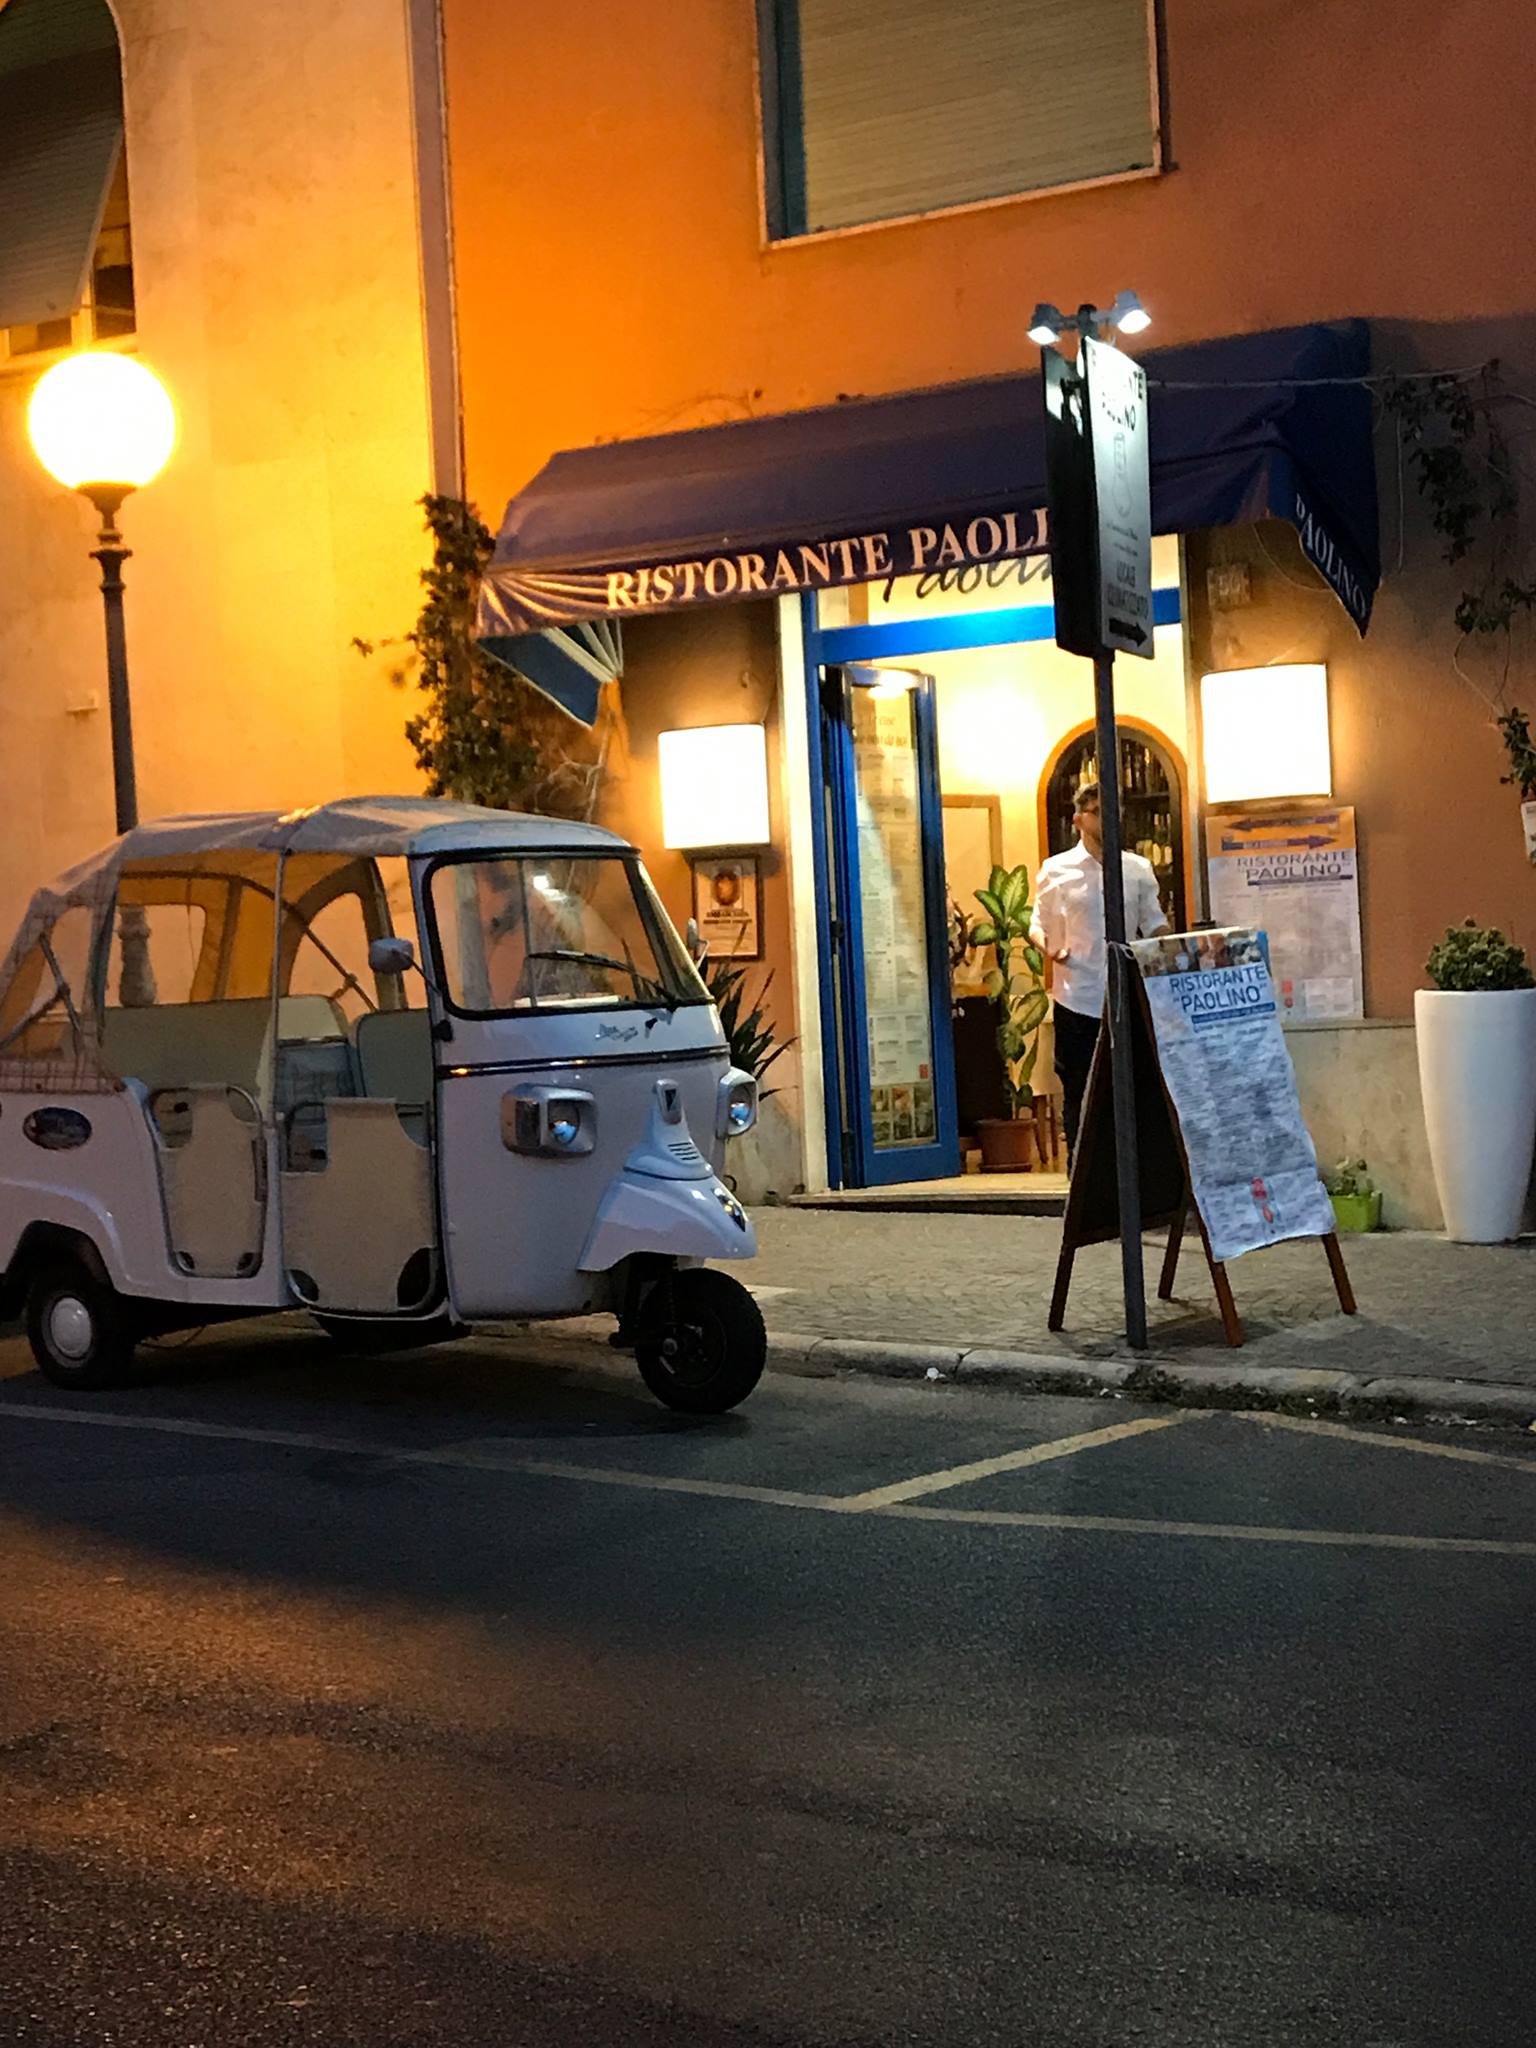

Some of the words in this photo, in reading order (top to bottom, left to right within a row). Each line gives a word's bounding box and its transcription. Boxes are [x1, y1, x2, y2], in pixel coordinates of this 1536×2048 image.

[606, 533, 893, 610] RISTORANTE
[907, 506, 1049, 570] PAOLI
[1237, 851, 1352, 867] RISTORANTE
[1169, 965, 1268, 993] RISTORANTE
